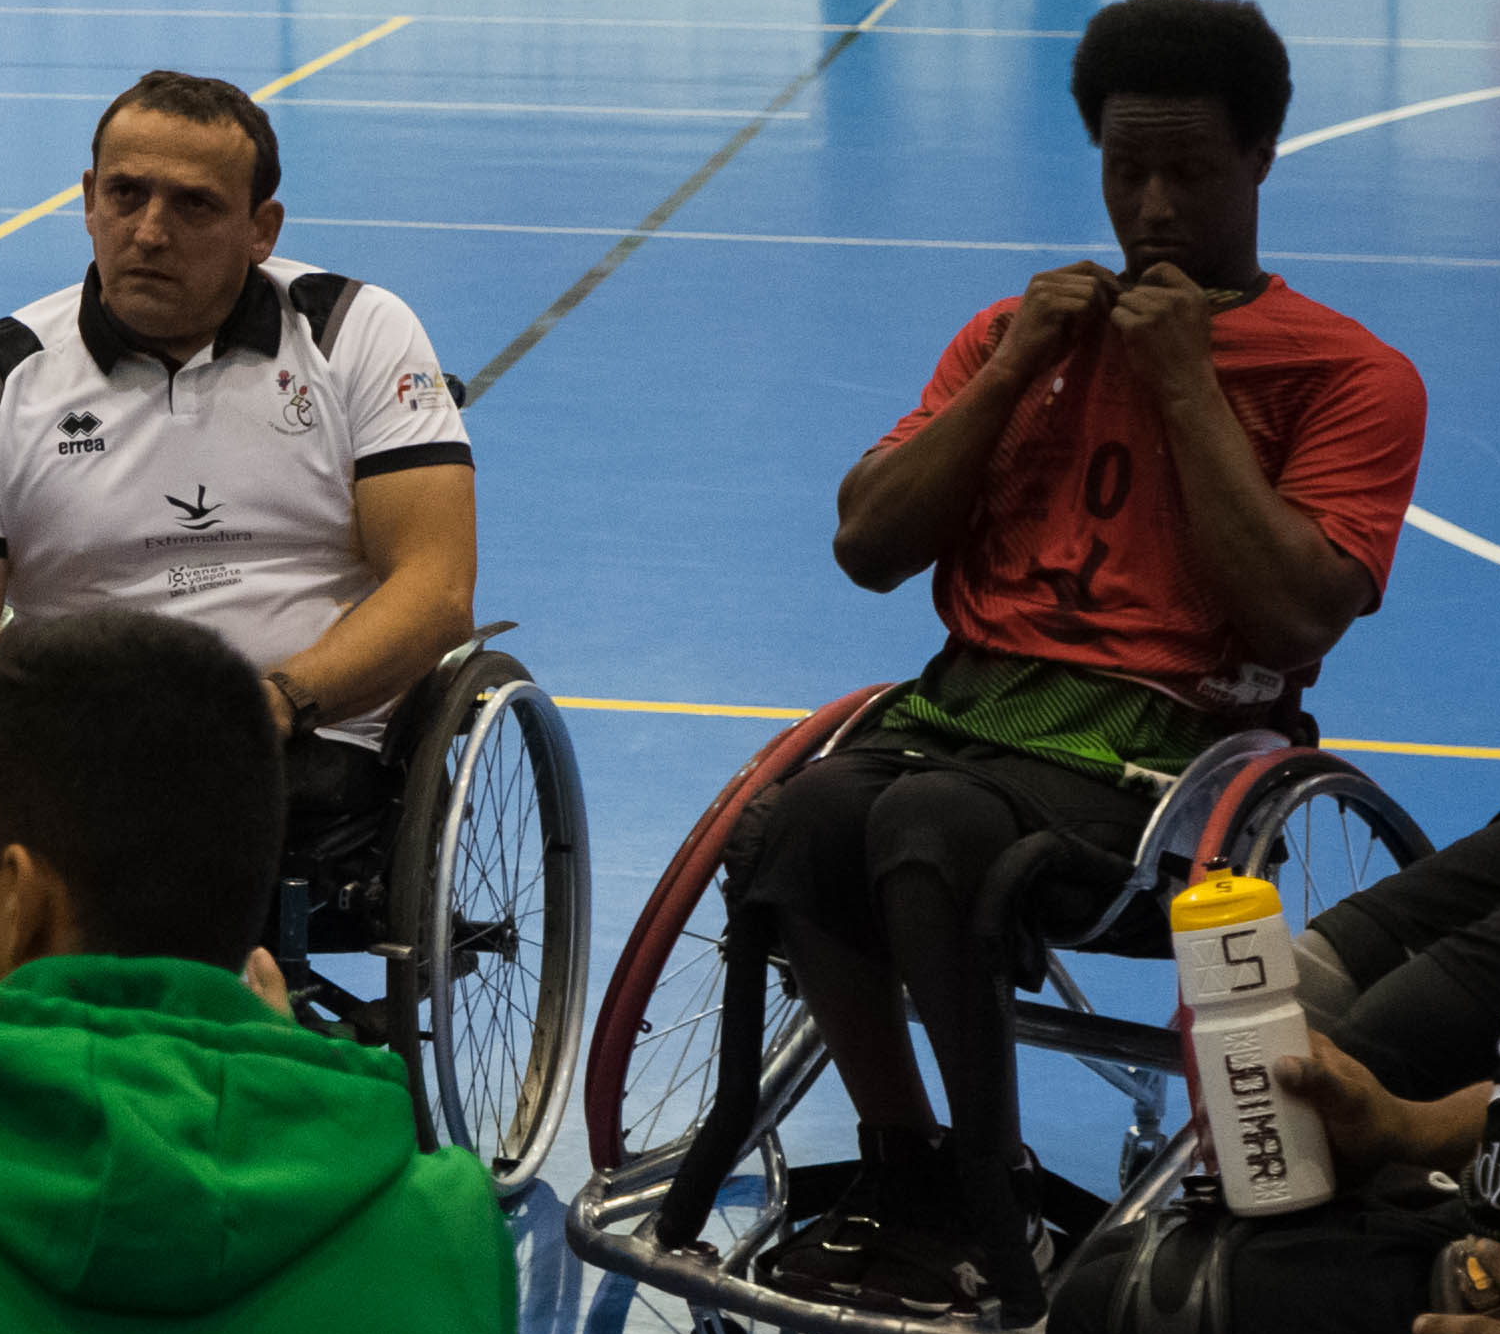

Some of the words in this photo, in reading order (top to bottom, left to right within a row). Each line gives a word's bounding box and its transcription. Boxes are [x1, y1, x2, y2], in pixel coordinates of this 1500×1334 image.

[58, 438, 105, 455] errea
[1085, 440, 1132, 520] 0
[145, 530, 253, 548] Extremadura
[1221, 928, 1267, 993] 5
